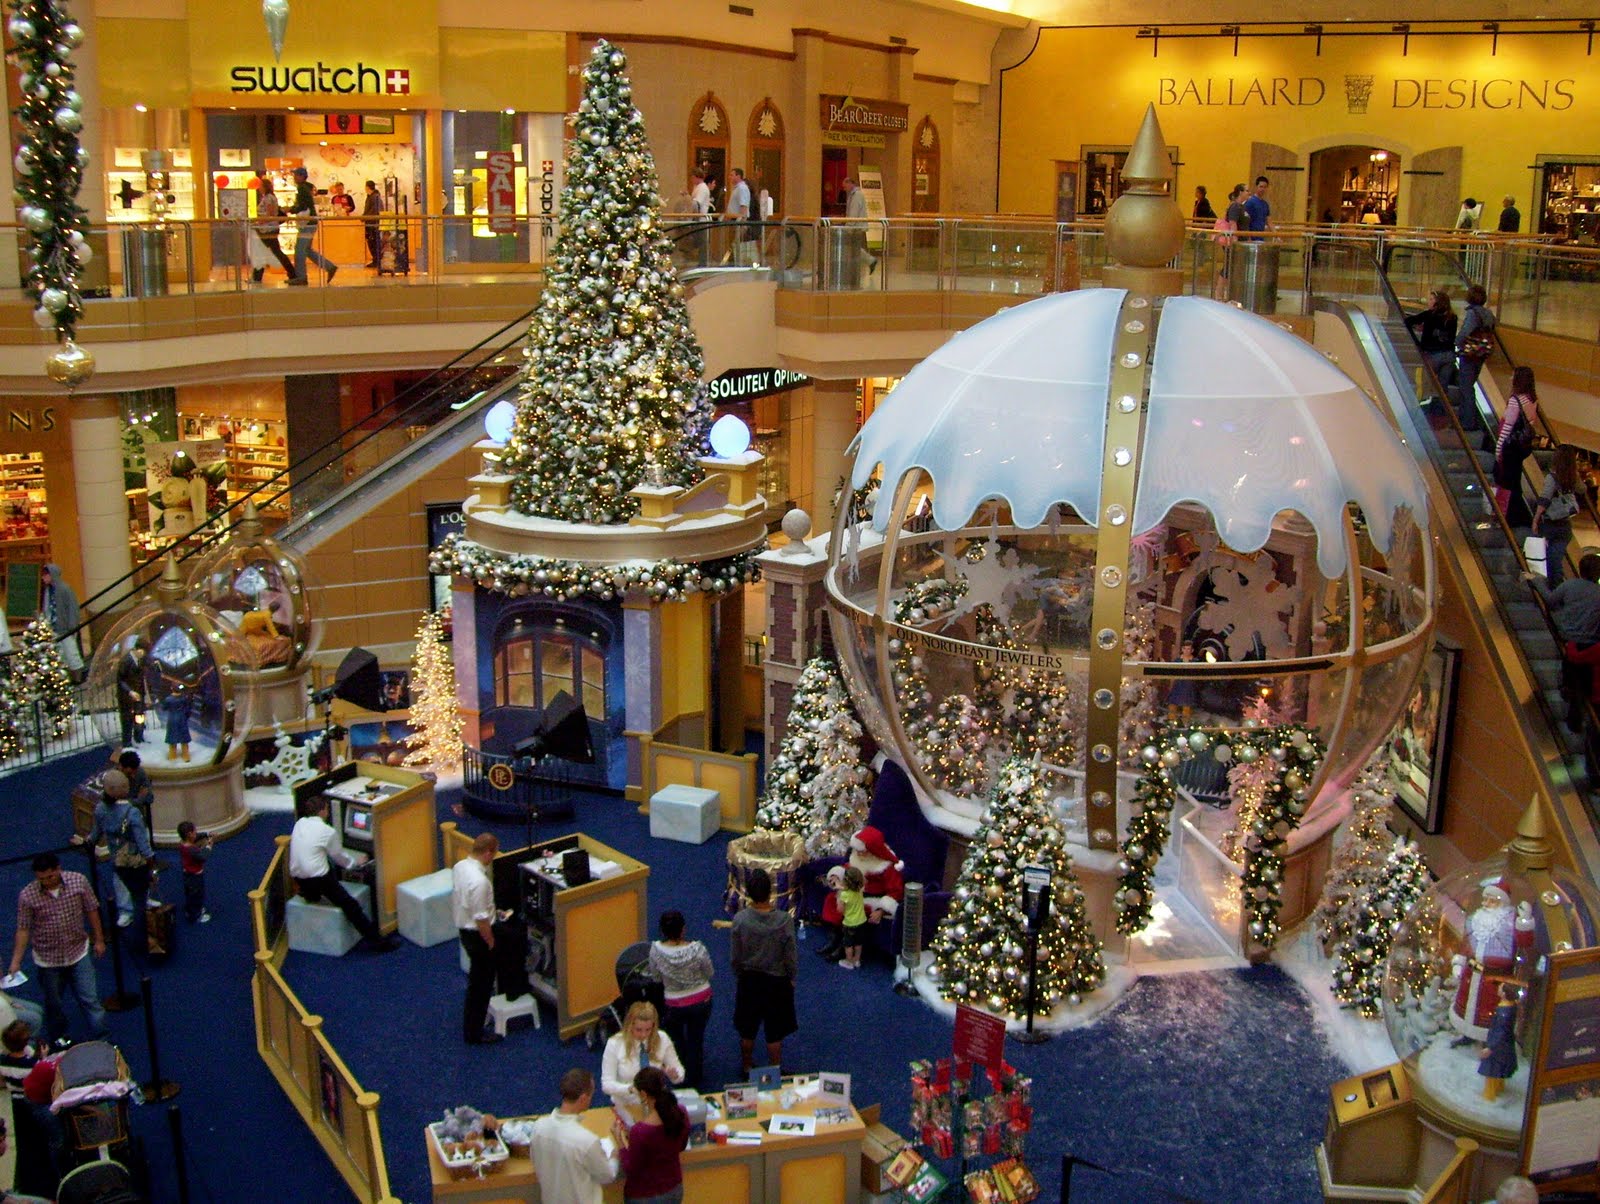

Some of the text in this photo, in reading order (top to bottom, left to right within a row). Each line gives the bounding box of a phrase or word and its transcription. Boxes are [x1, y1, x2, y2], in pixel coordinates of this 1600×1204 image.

[231, 61, 381, 94] swatch
[1159, 77, 1575, 111] BALLARD DESIGNS
[883, 115, 907, 129] CLOSETS
[488, 154, 513, 230] SALE
[896, 627, 1063, 669] OLD NORTHEAST JEWELERS
